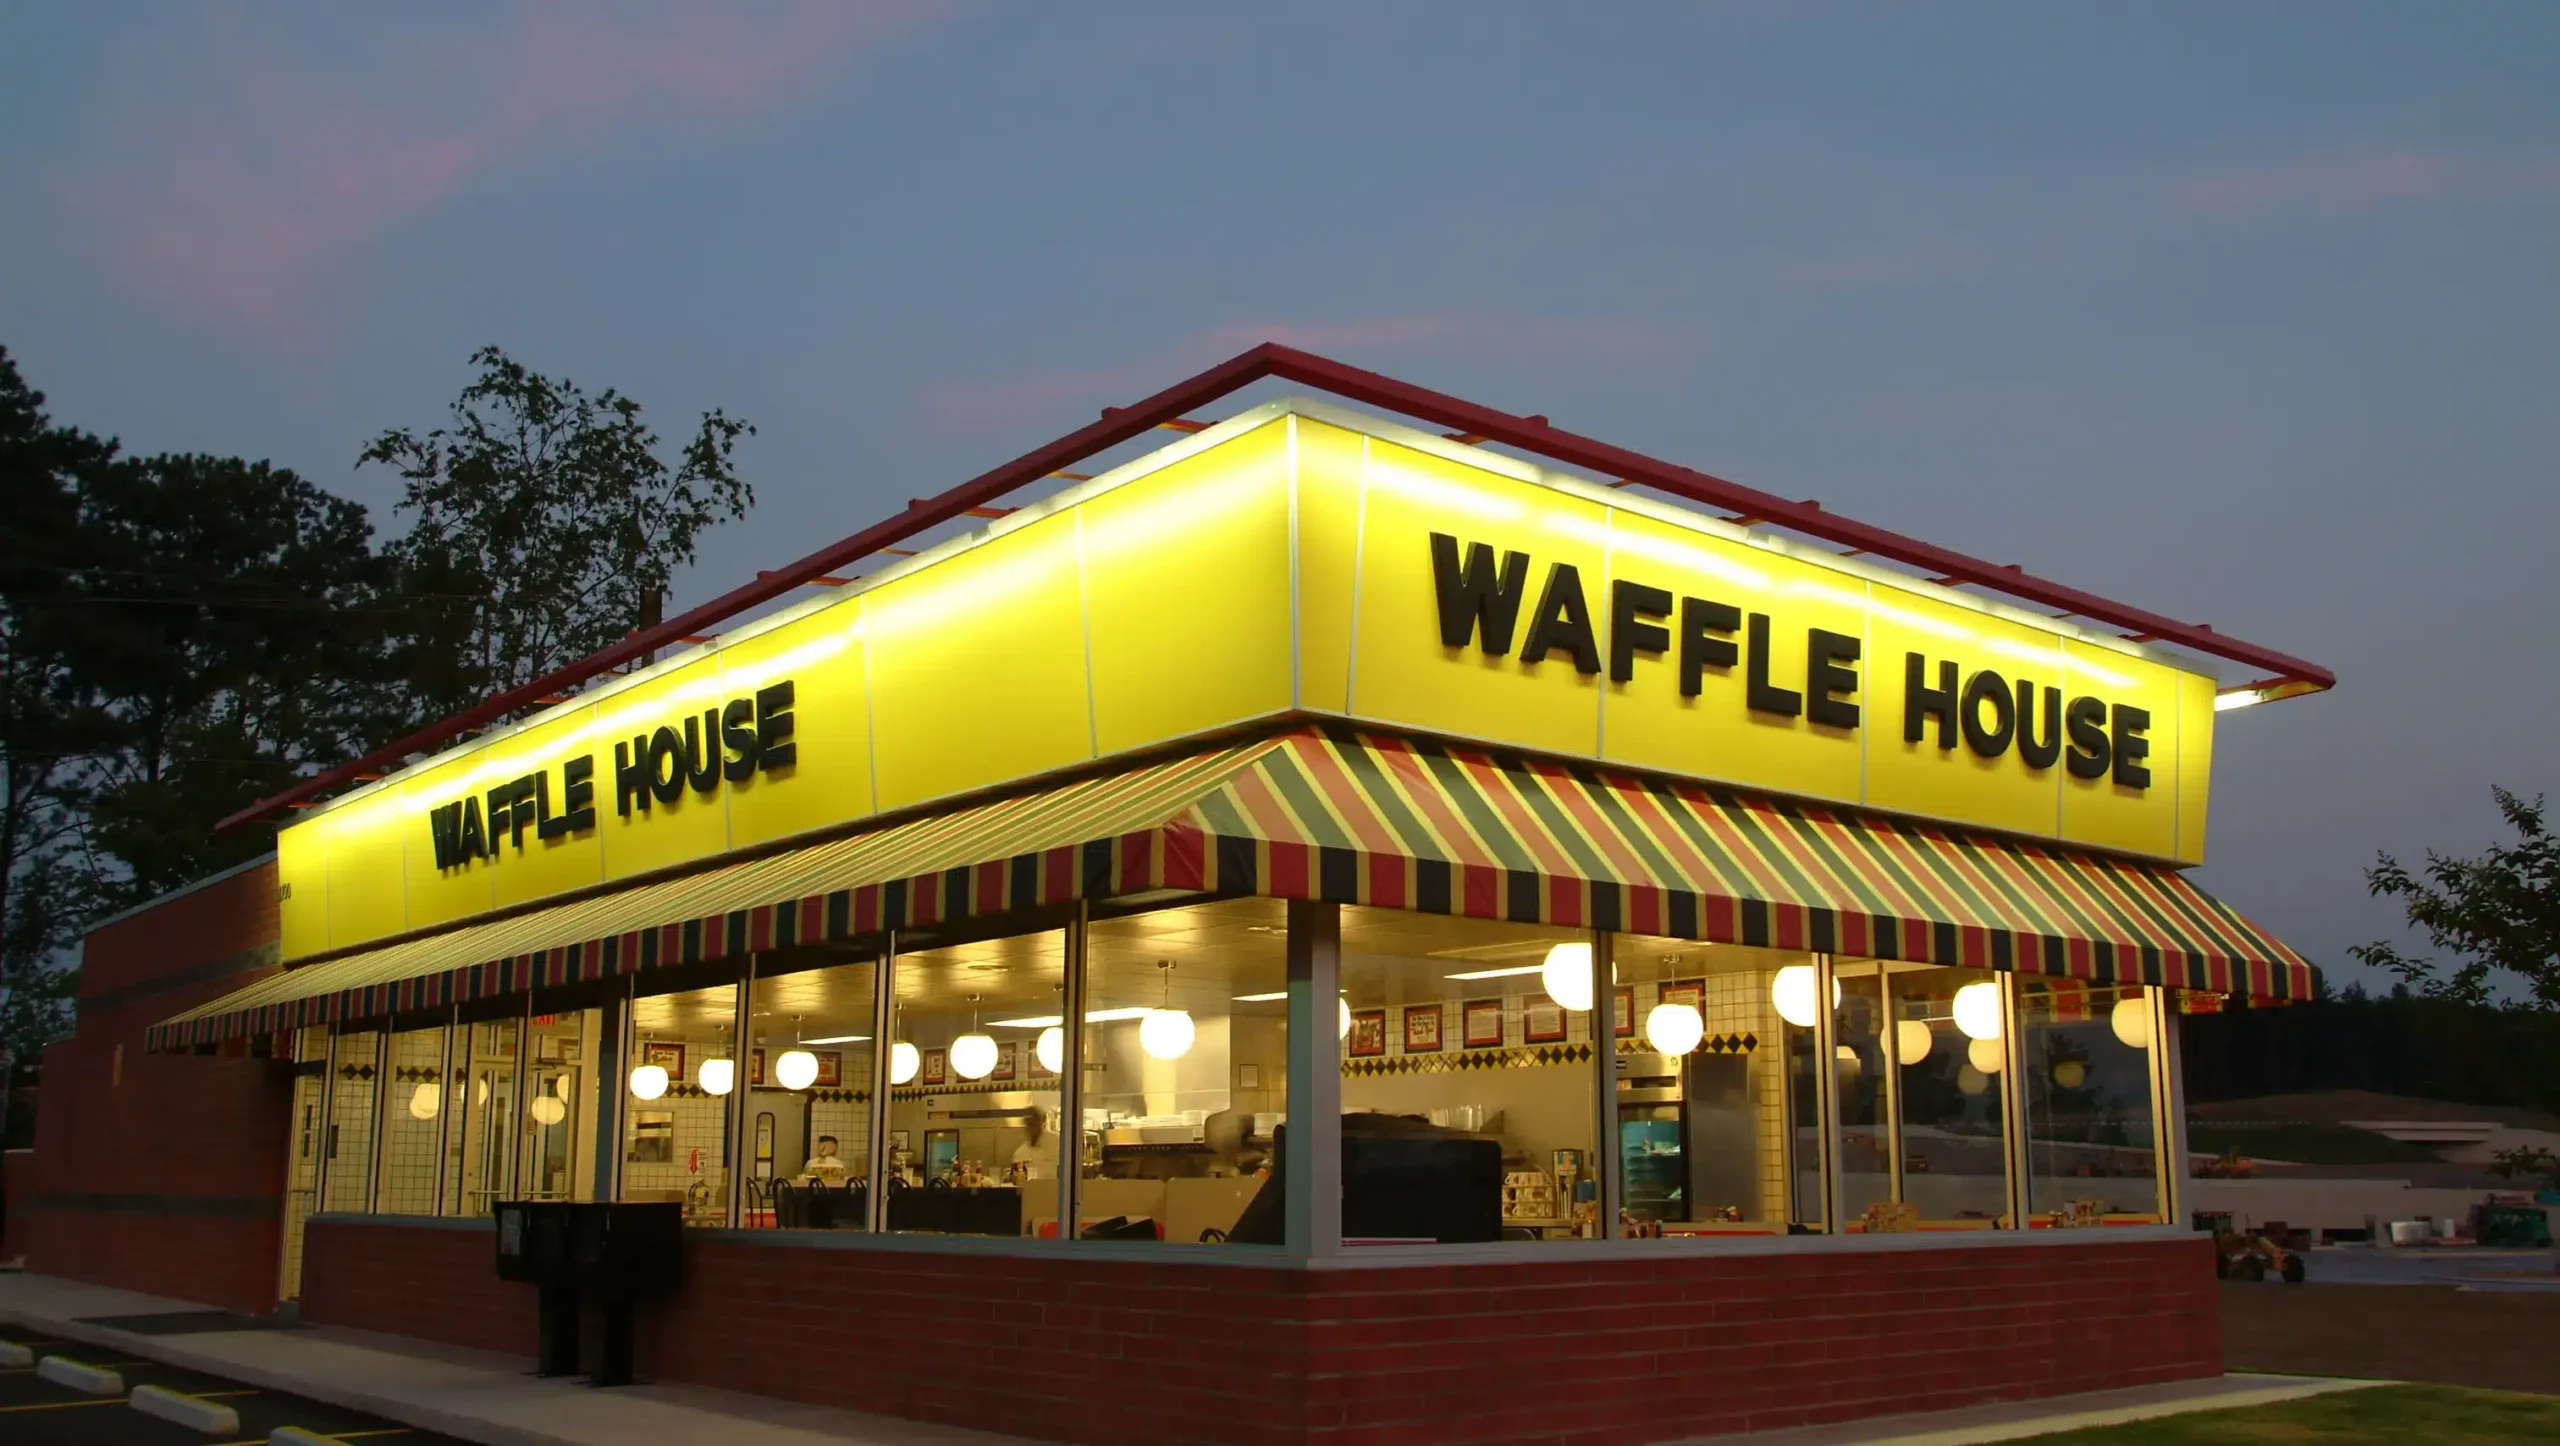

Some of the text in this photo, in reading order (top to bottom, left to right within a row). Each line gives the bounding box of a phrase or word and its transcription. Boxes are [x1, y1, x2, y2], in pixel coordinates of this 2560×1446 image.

[1430, 531, 2151, 789] WAFFLE HOUSE
[430, 680, 797, 870] WAFFLE HOUSE
